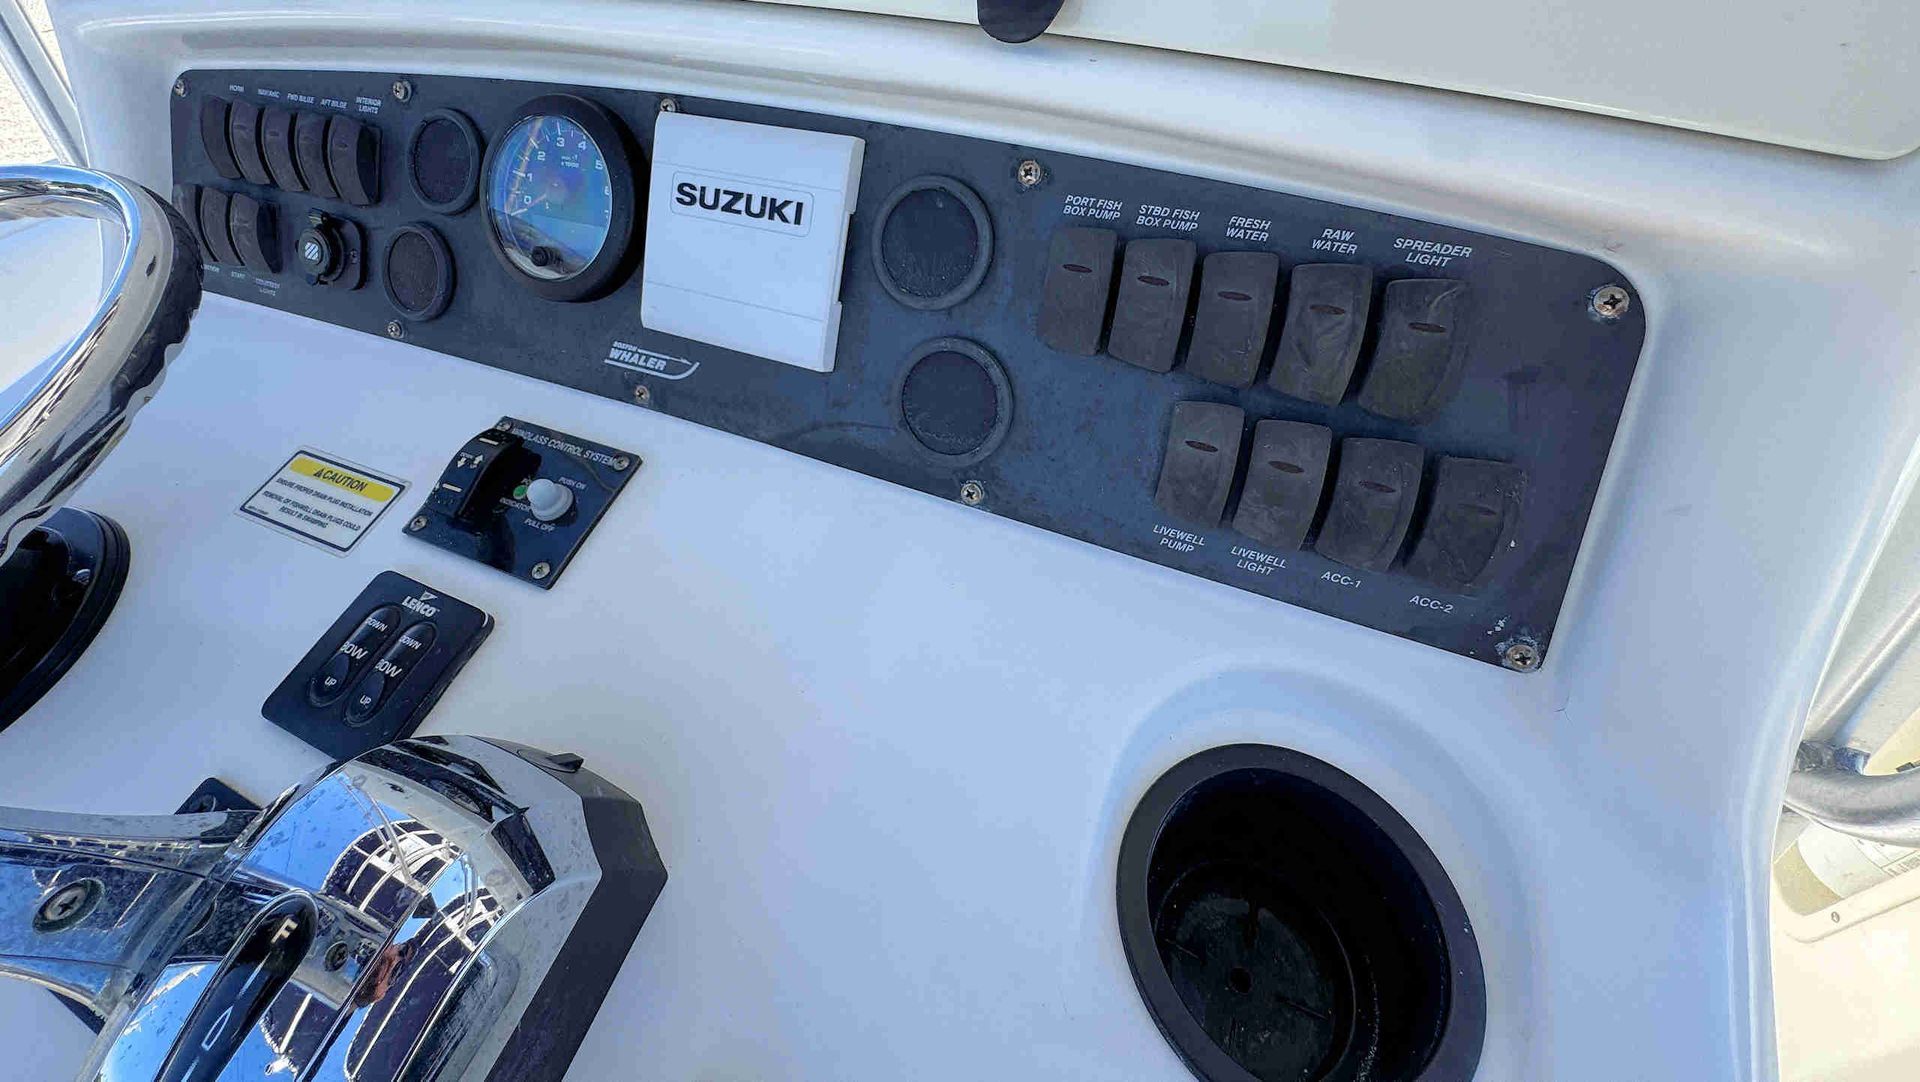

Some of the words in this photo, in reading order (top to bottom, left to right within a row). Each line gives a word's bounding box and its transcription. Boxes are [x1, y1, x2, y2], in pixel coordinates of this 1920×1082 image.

[355, 96, 382, 107] INTERIOR
[358, 105, 379, 114] LIGHTS
[556, 137, 565, 147] 3
[578, 141, 586, 150] 4
[537, 151, 546, 161] 2
[595, 159, 603, 170] 5
[523, 195, 532, 204] 0
[675, 182, 804, 226] SUZUKI
[1064, 194, 1096, 208] PORT
[1096, 198, 1123, 211] FISH
[1063, 205, 1088, 217] BOX
[1087, 208, 1121, 221] PUMP
[1138, 204, 1171, 217] STBD
[1171, 208, 1201, 221] FISH
[1135, 215, 1162, 227] BOX
[1162, 219, 1199, 232] PUMP
[1228, 216, 1272, 231] FRESH
[1225, 227, 1269, 242] WATER
[1321, 228, 1355, 241] RAW
[1311, 239, 1358, 255] WATER
[1393, 237, 1473, 258] SPREADER
[1405, 253, 1453, 268] LIGHT
[609, 347, 667, 371] WHALER
[548, 435, 585, 456] CONTROL
[322, 469, 368, 492] CAUTION
[524, 518, 540, 530] PULL
[539, 523, 556, 533] OFF
[1152, 524, 1206, 546] LIVEWELL
[1159, 537, 1195, 553] PUMP
[1230, 546, 1289, 569] LIVEWELL
[1236, 558, 1276, 577] LIGHT
[1320, 571, 1362, 588] ACC-1
[401, 595, 437, 618] LENCO
[1409, 595, 1455, 613] ACC-2
[366, 617, 389, 632] DOWN
[399, 634, 422, 650] DOWN
[339, 641, 369, 660] BOW
[374, 658, 403, 678] BOW
[324, 676, 338, 687] UP
[359, 694, 372, 706] UP
[270, 916, 299, 944] F
